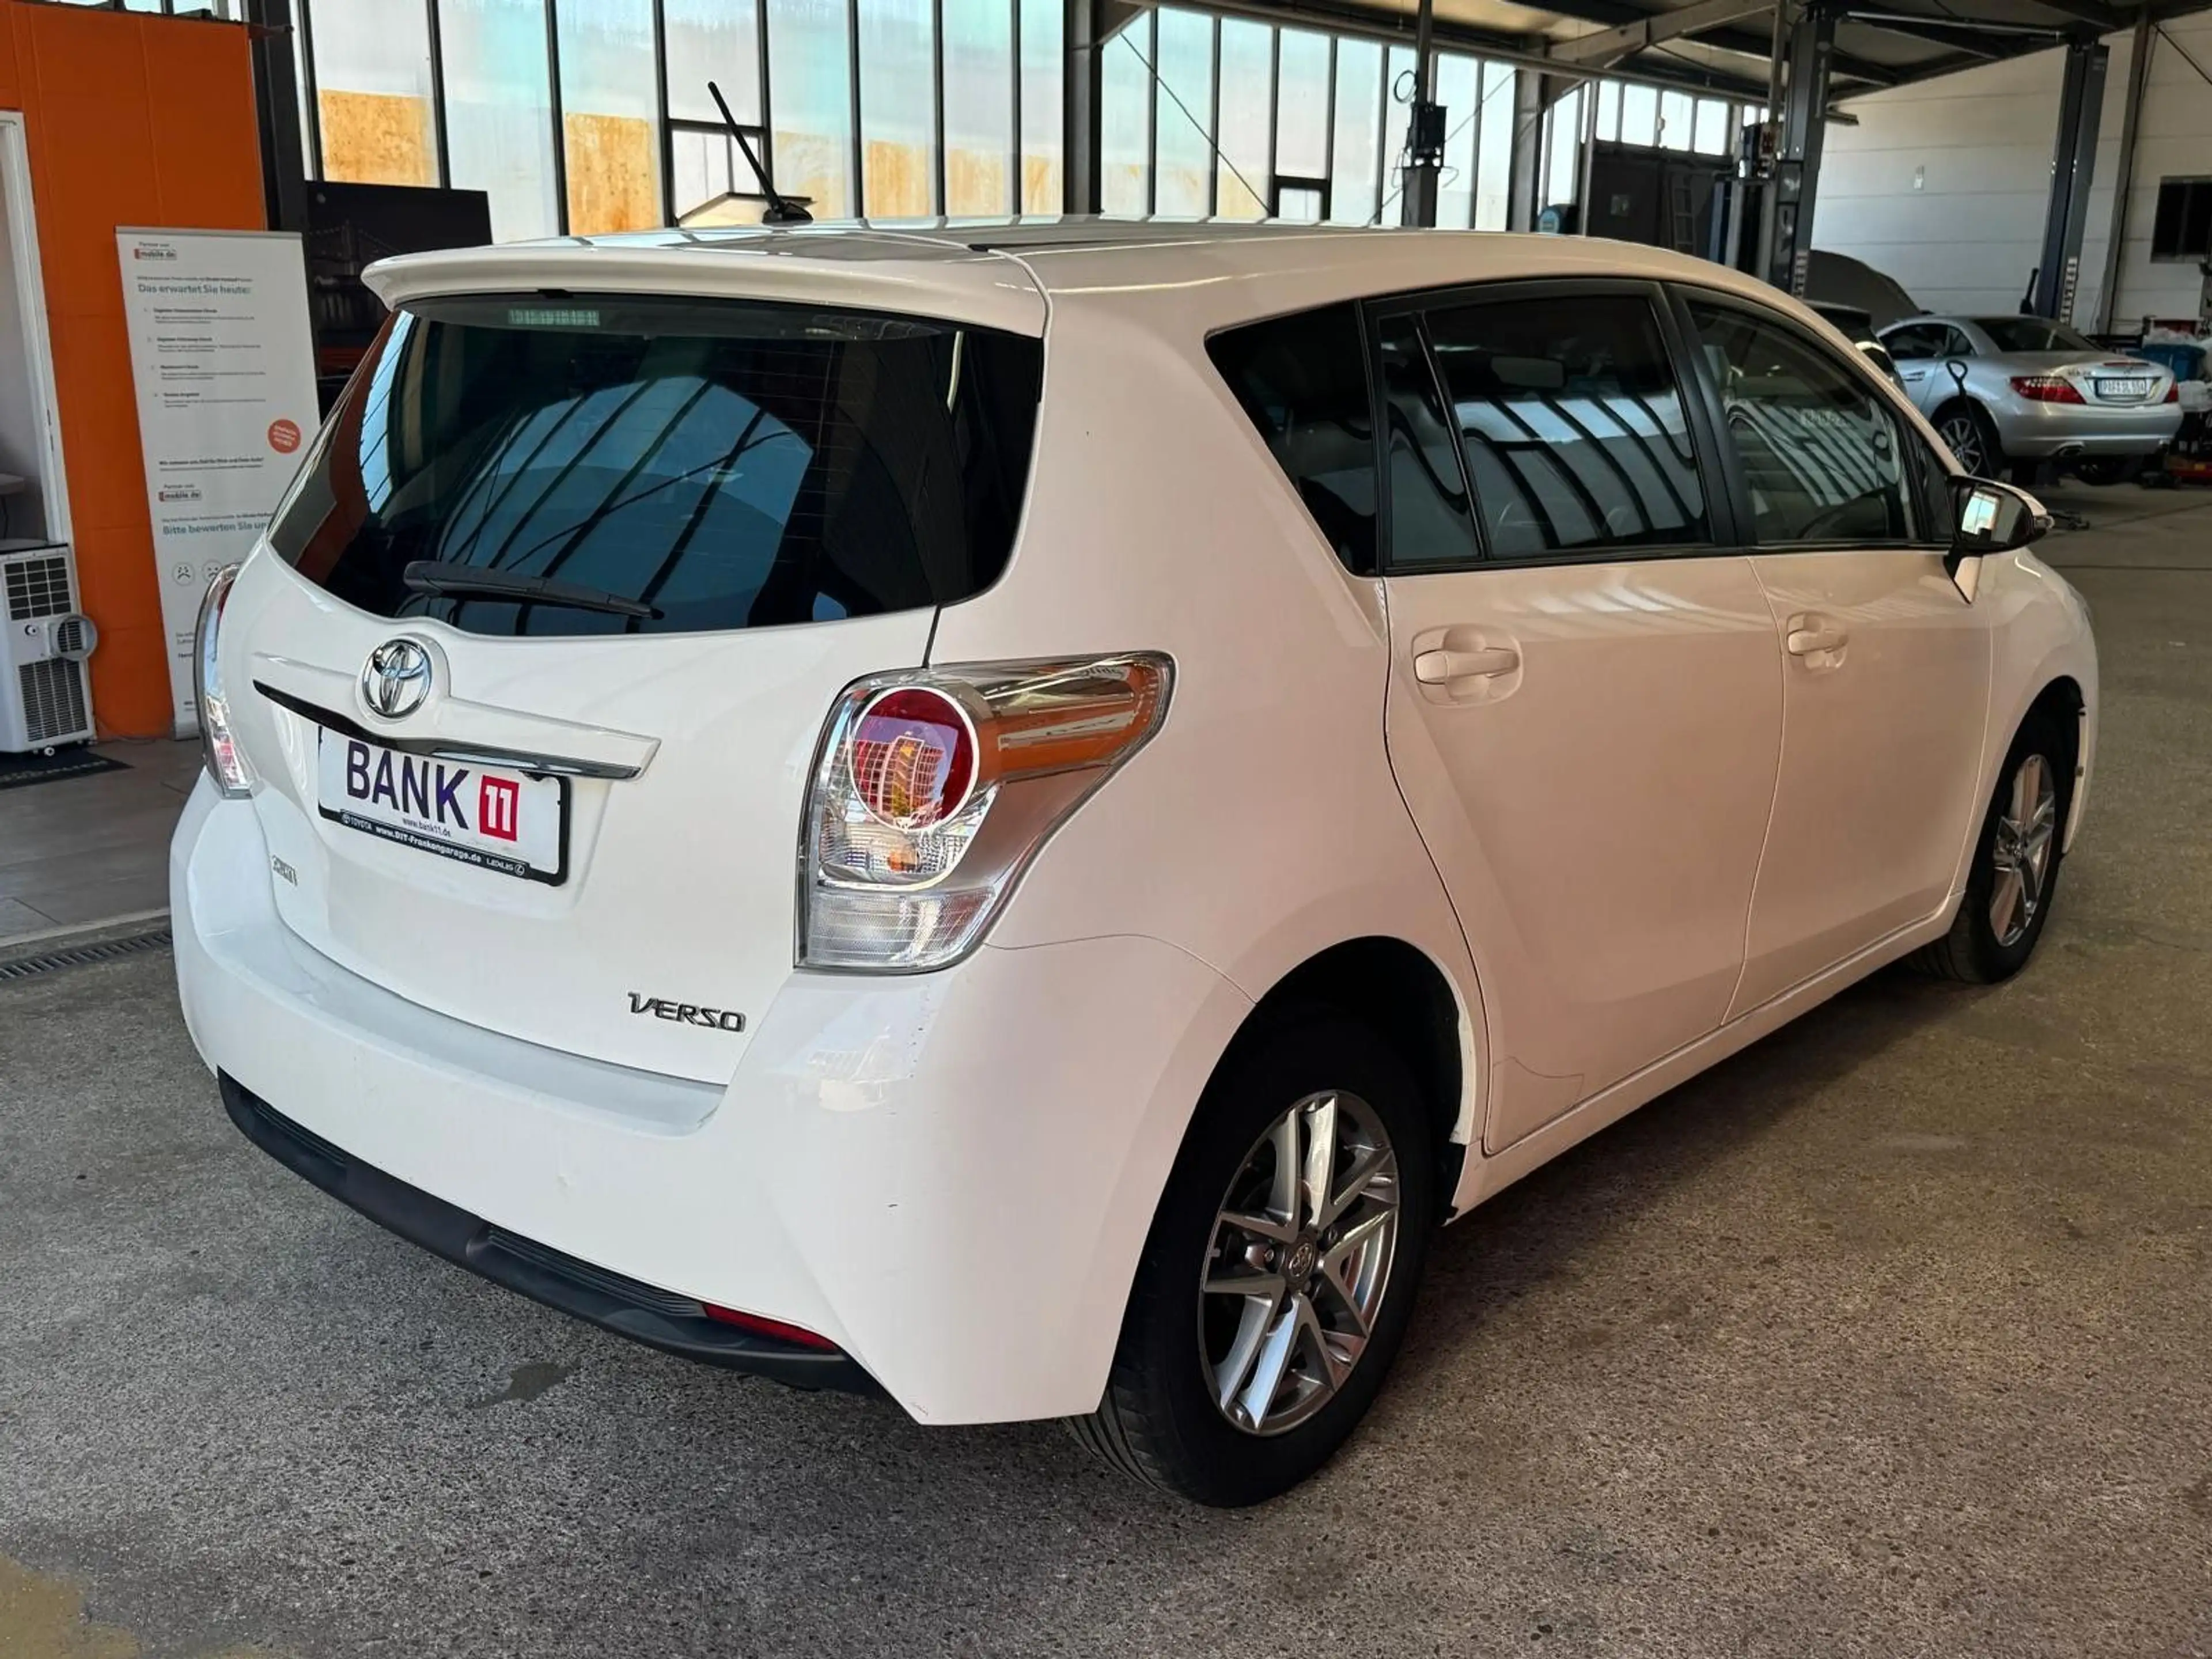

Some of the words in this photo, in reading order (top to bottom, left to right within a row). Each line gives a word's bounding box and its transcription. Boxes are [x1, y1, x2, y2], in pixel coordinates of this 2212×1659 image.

[138, 283, 157, 294] Das
[159, 284, 202, 294] erwartet
[203, 284, 218, 294] Sie
[163, 524, 186, 535] Bitte
[188, 523, 236, 534] bewerten
[237, 522, 252, 531] Sie
[347, 740, 469, 830] BANK
[485, 784, 513, 833] 11
[402, 817, 452, 838] www.bank11.de
[627, 991, 747, 1033] VERSO
